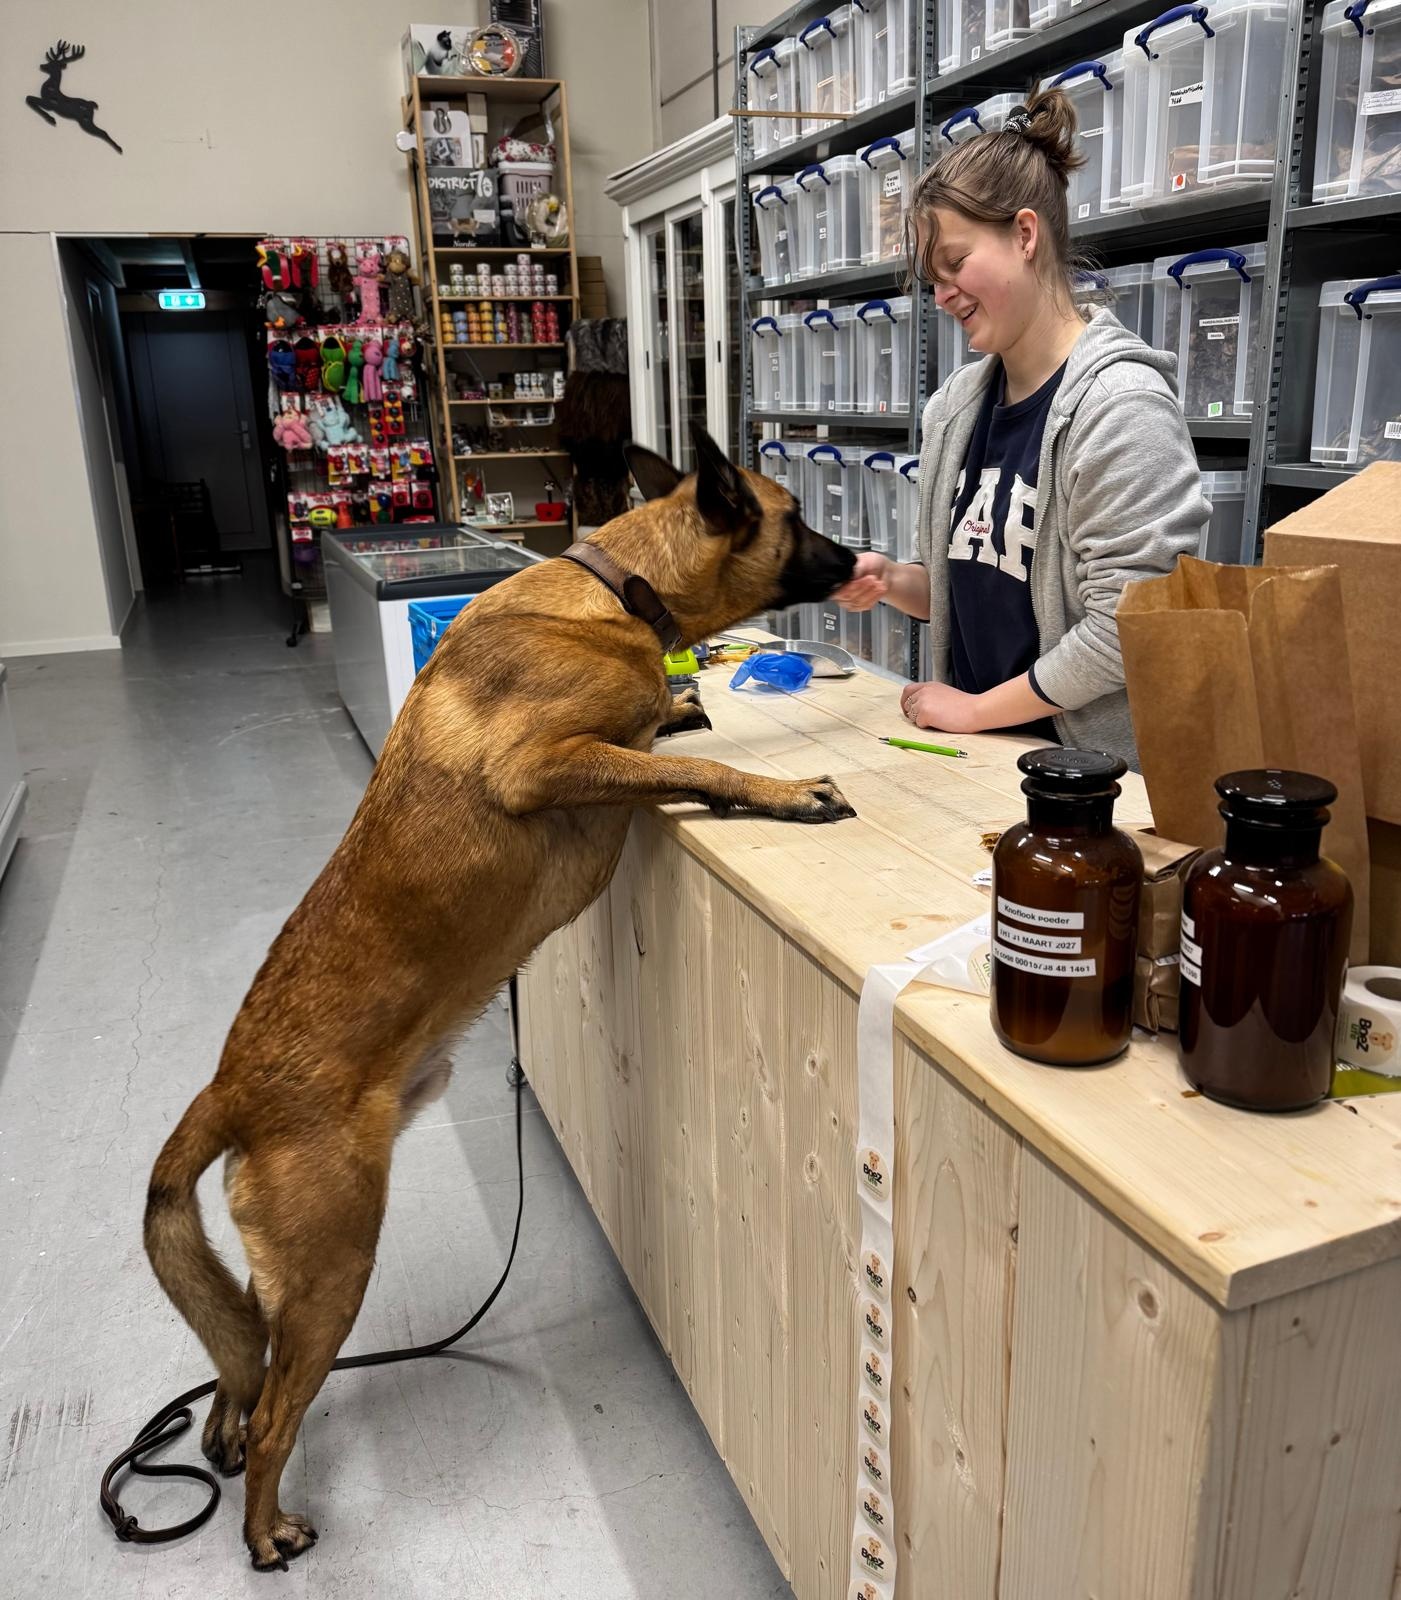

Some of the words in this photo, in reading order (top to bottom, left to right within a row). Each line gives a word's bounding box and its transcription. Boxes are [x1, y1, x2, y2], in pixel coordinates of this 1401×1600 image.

[453, 240, 477, 248] Nordic
[963, 520, 990, 535] Original
[1004, 904, 1036, 920] Knoflook
[1038, 914, 1070, 925] poeder
[1022, 936, 1052, 948] MAART
